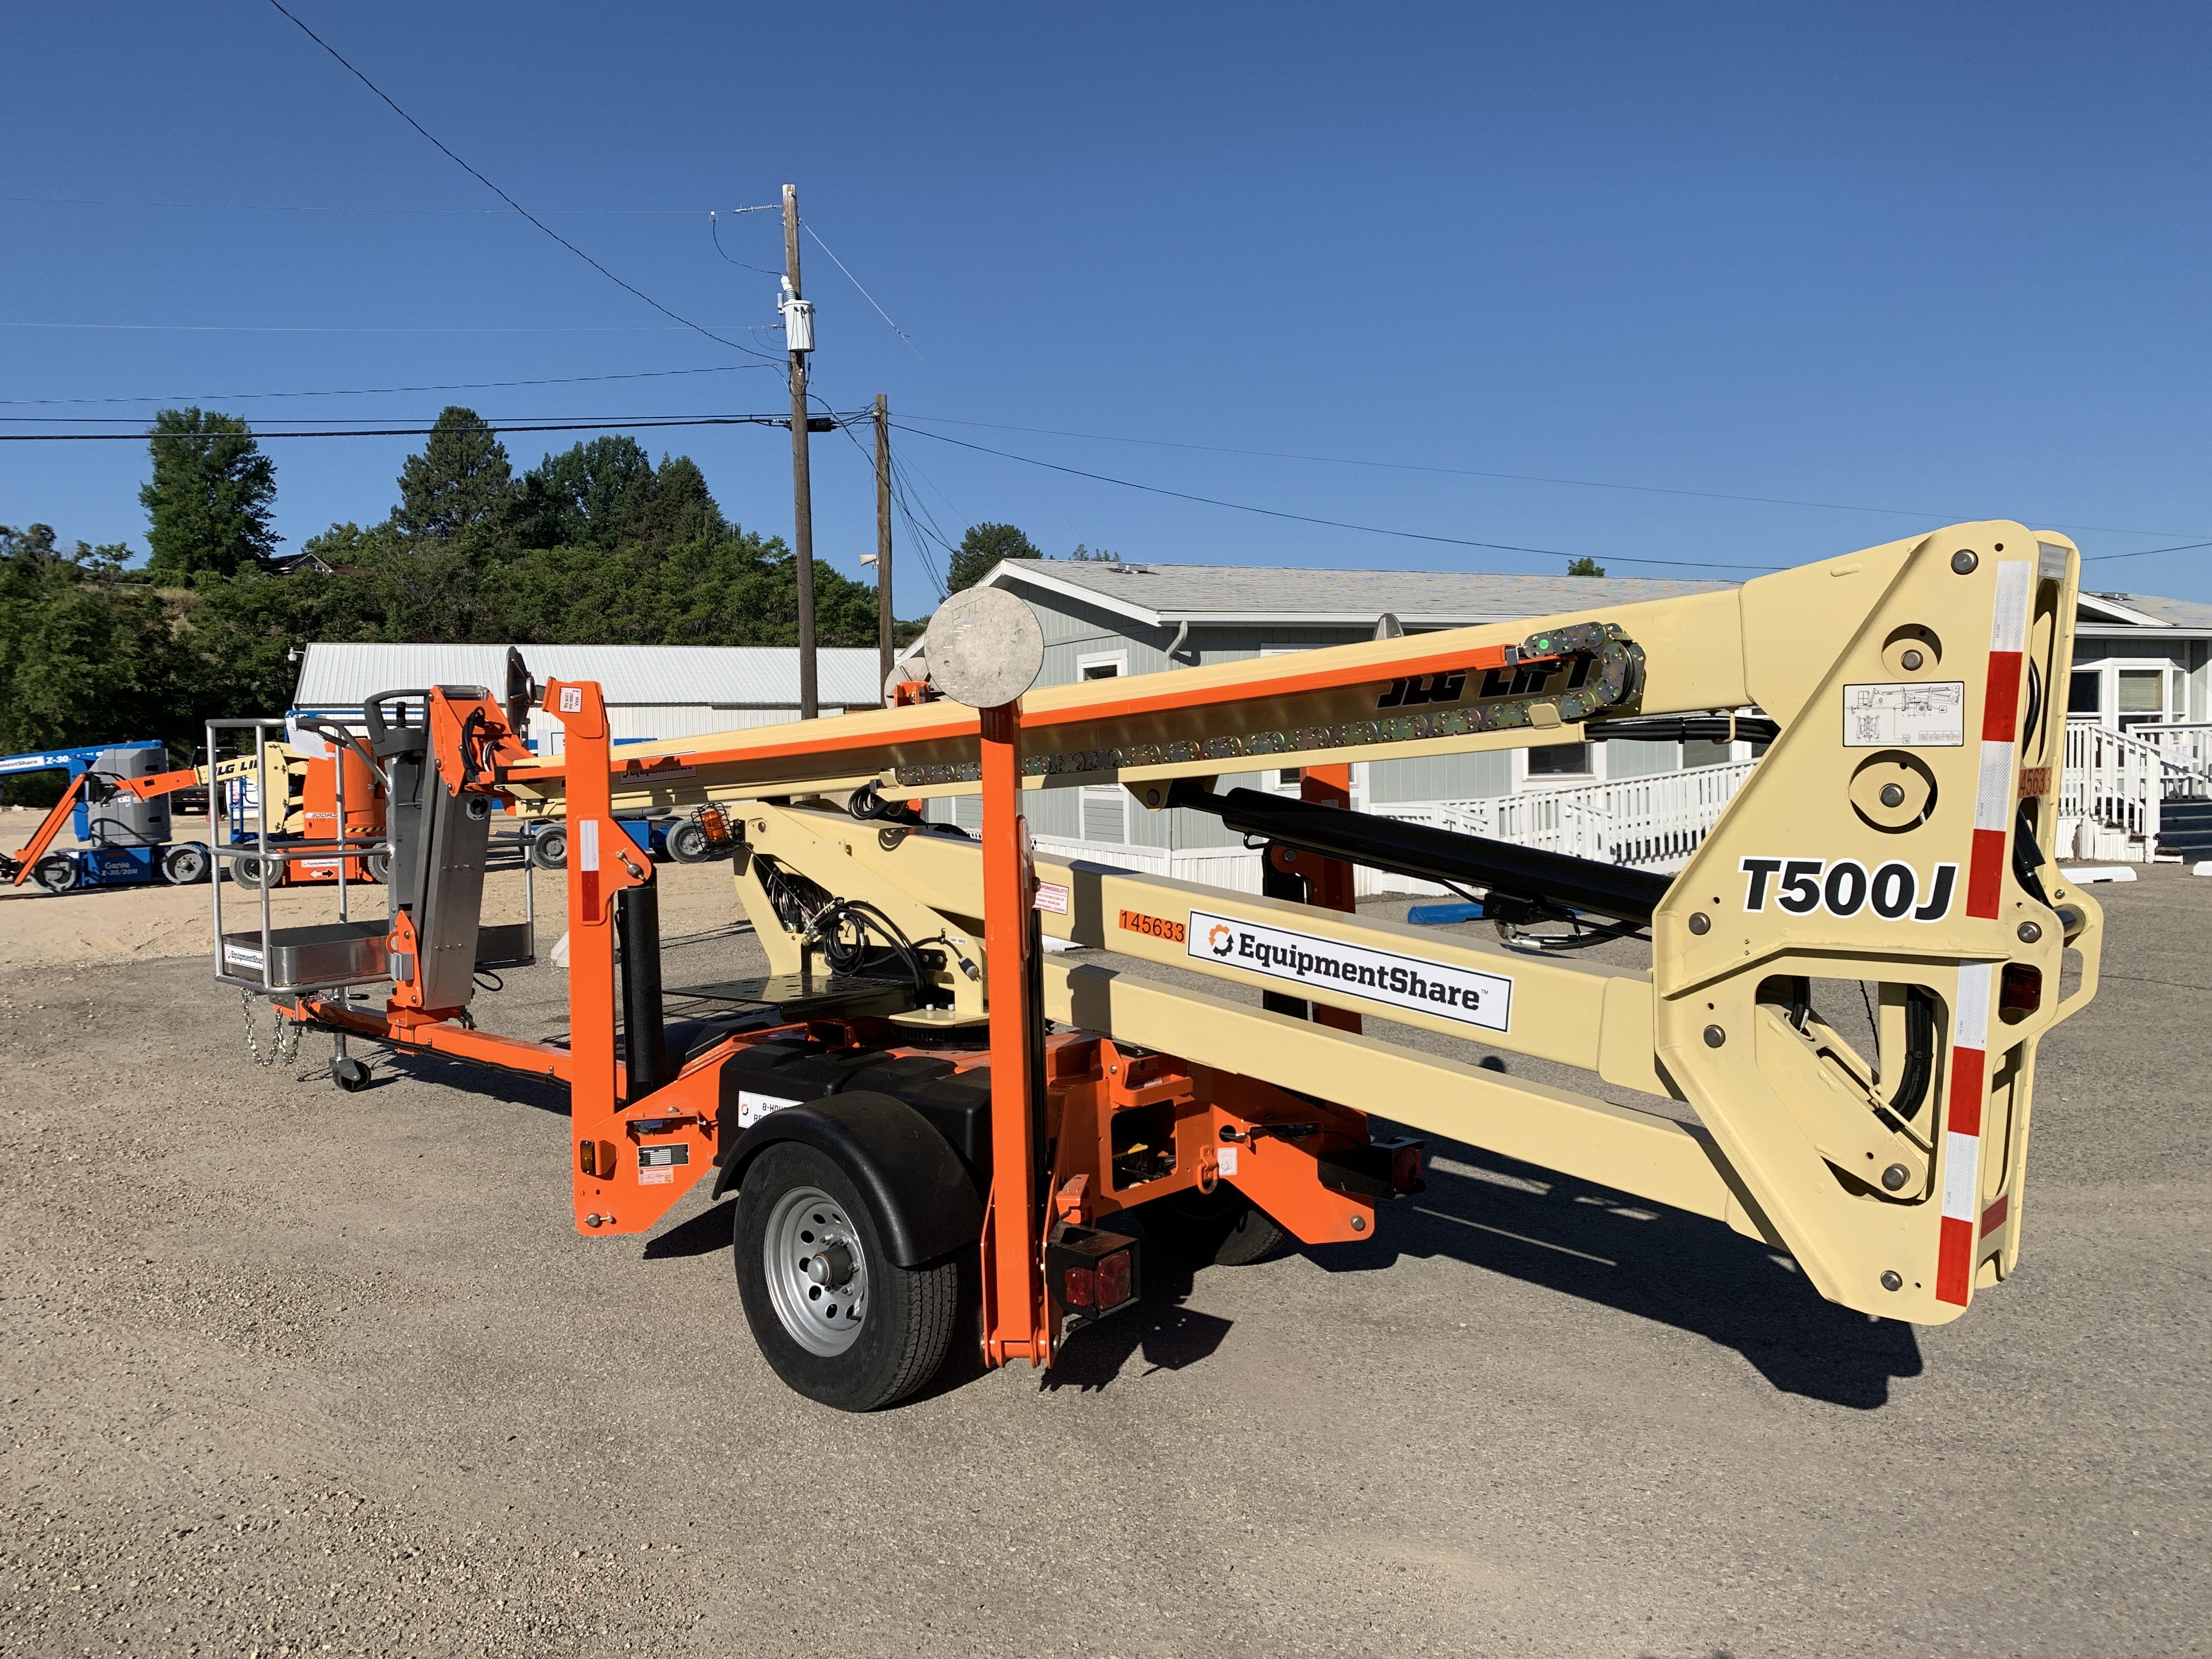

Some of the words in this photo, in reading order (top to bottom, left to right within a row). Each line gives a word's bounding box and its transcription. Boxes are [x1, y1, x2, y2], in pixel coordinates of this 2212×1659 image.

[1376, 672, 1470, 710] JLG
[1739, 857, 1958, 922] T500J
[1122, 911, 1184, 942] 145633
[1238, 933, 1480, 1011] EquipmentShare
